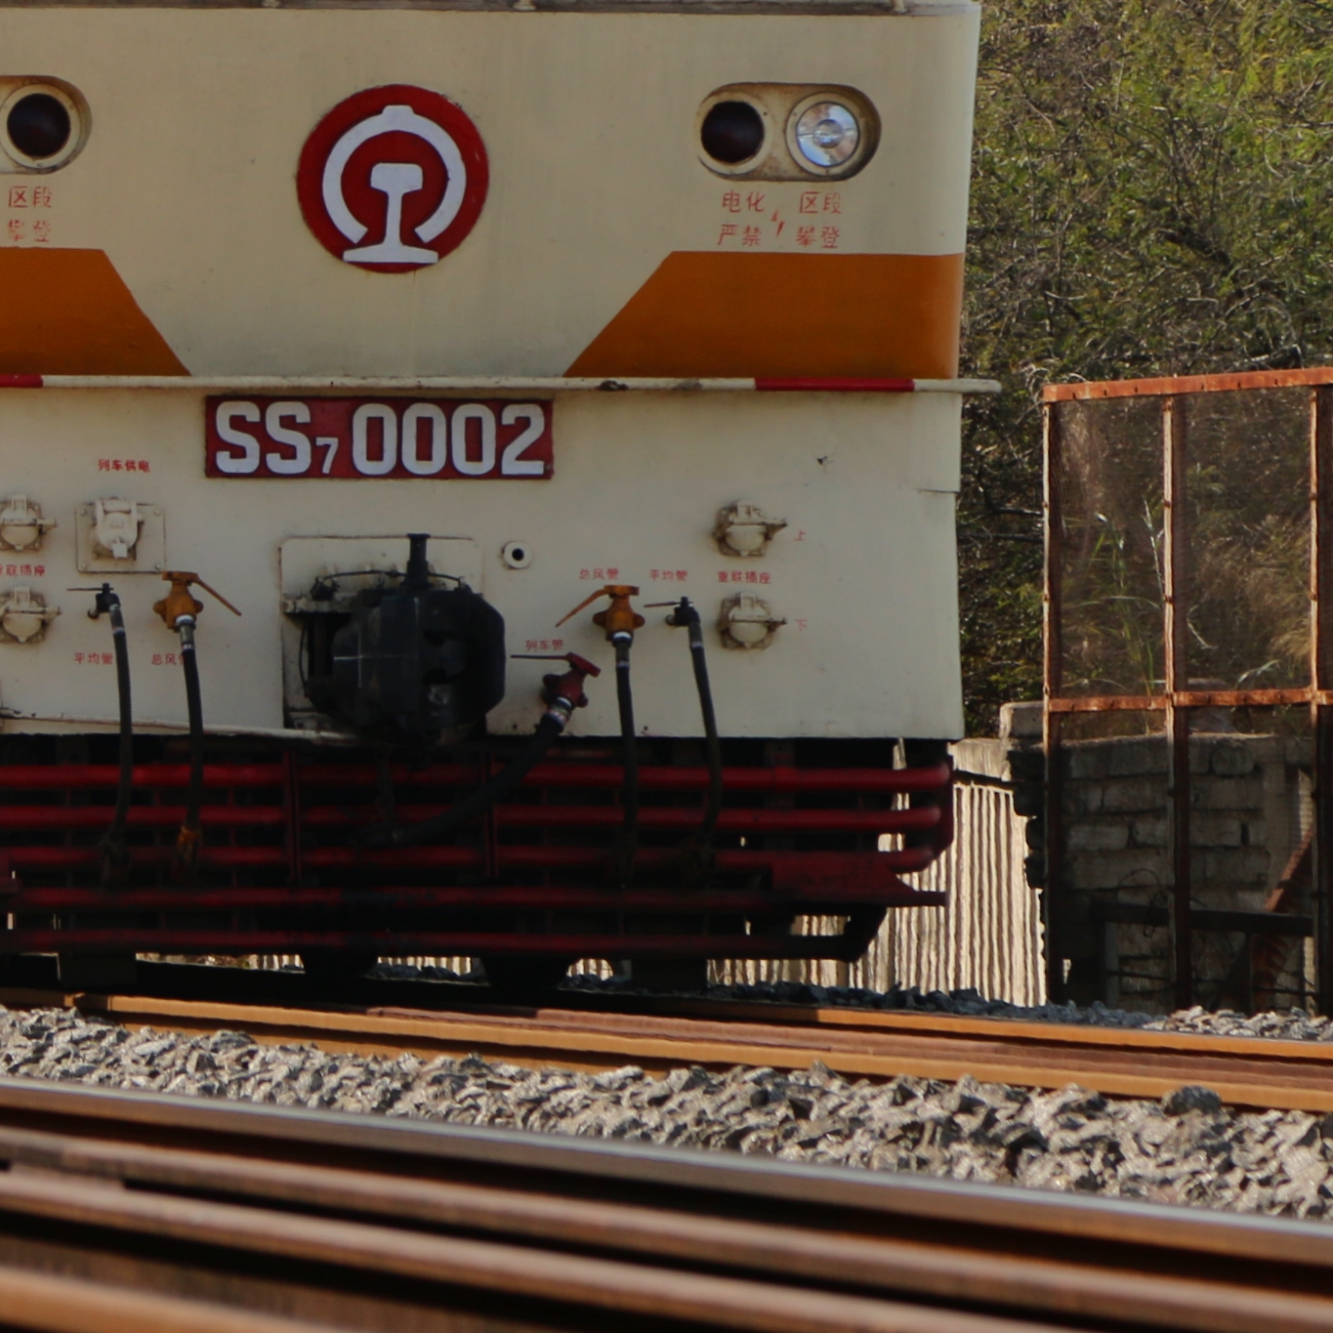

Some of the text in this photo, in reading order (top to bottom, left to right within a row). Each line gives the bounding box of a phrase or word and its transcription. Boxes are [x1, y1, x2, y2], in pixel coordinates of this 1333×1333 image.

[8, 185, 52, 208] 区段
[722, 190, 842, 214] 电化 区段
[717, 224, 840, 249] 严禁 攀登
[215, 400, 546, 475] SS70002
[98, 459, 149, 472] 列车供电
[794, 530, 806, 542] 上
[579, 569, 619, 581] 总风管
[649, 570, 688, 582] 平均管
[717, 571, 772, 585] 重联插座
[796, 618, 807, 631] 下
[525, 639, 564, 652] 列车管
[73, 652, 114, 665] 平均管
